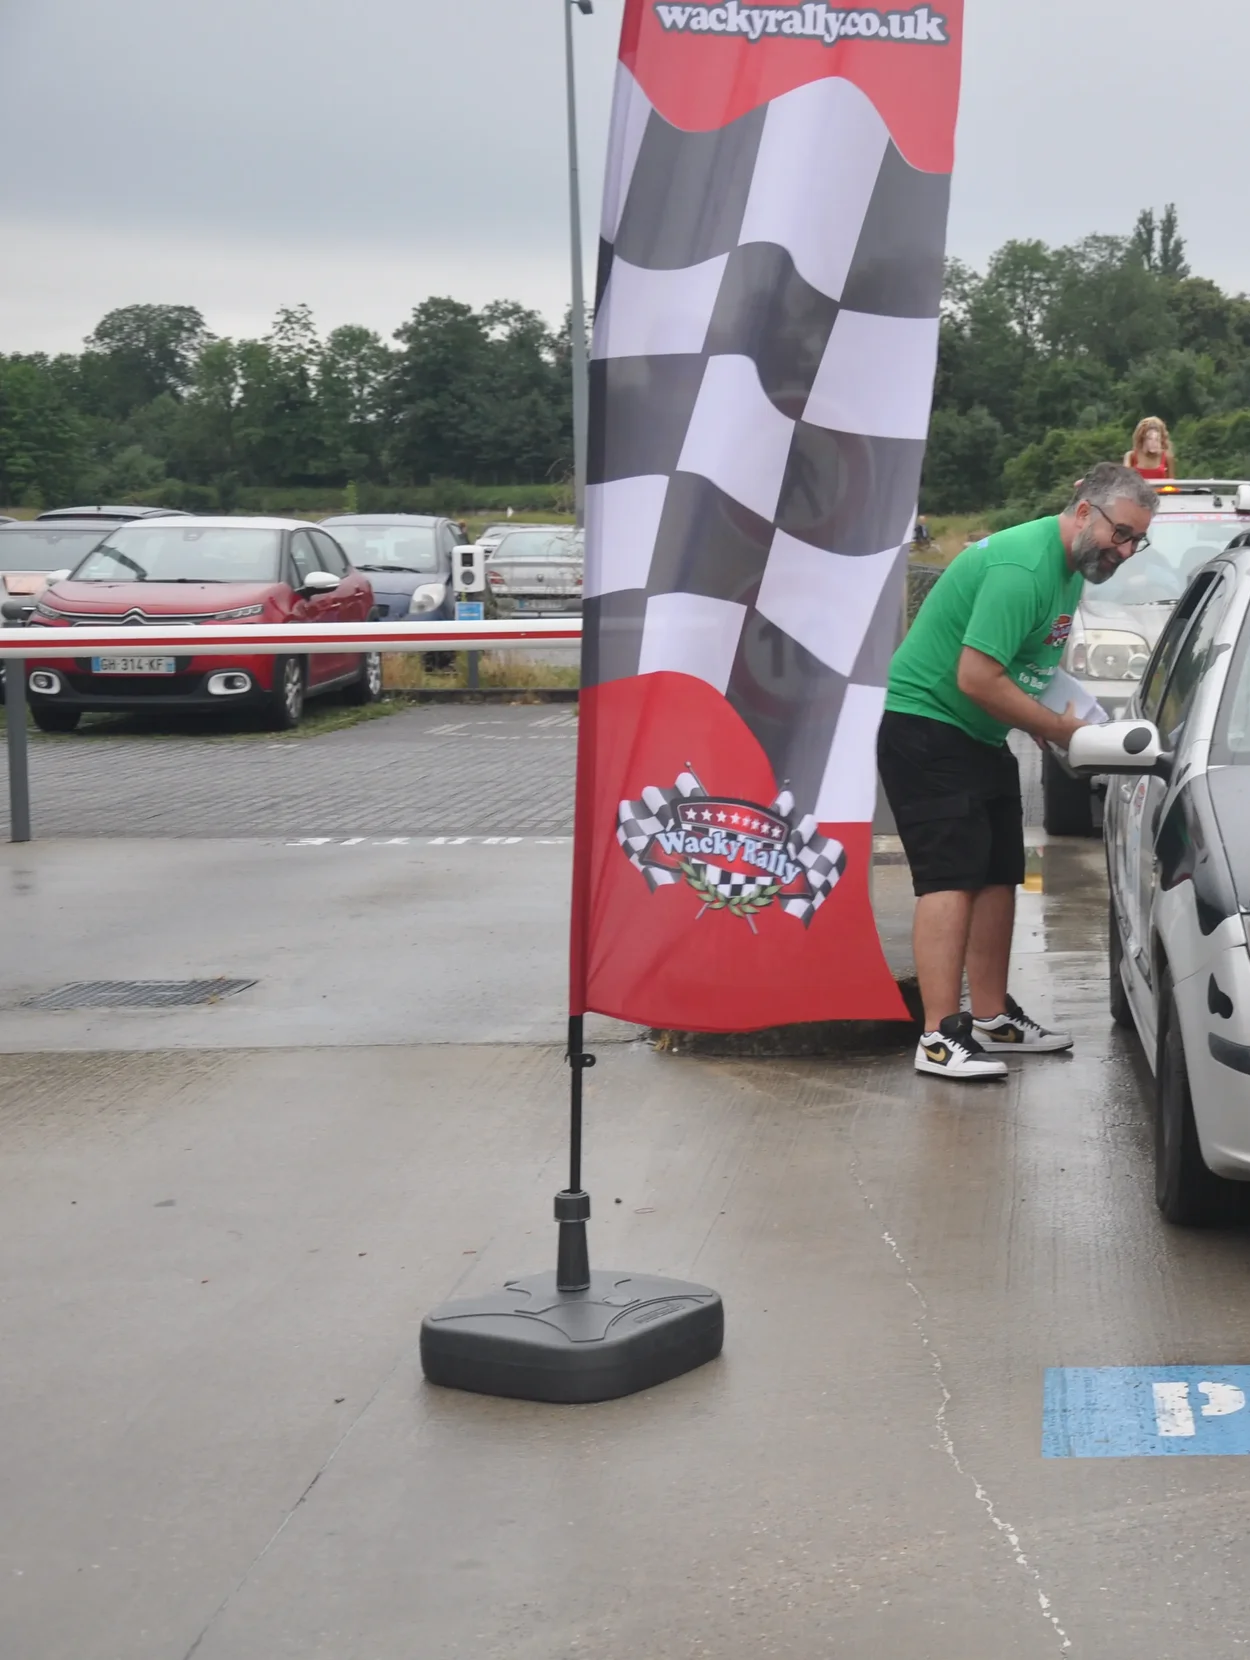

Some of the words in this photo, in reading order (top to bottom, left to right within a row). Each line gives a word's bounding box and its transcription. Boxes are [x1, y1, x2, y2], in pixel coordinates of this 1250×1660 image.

[655, 0, 949, 43] wackyrally.co.uk
[100, 658, 164, 671] GH-314-KF
[1152, 1381, 1247, 1437] P
